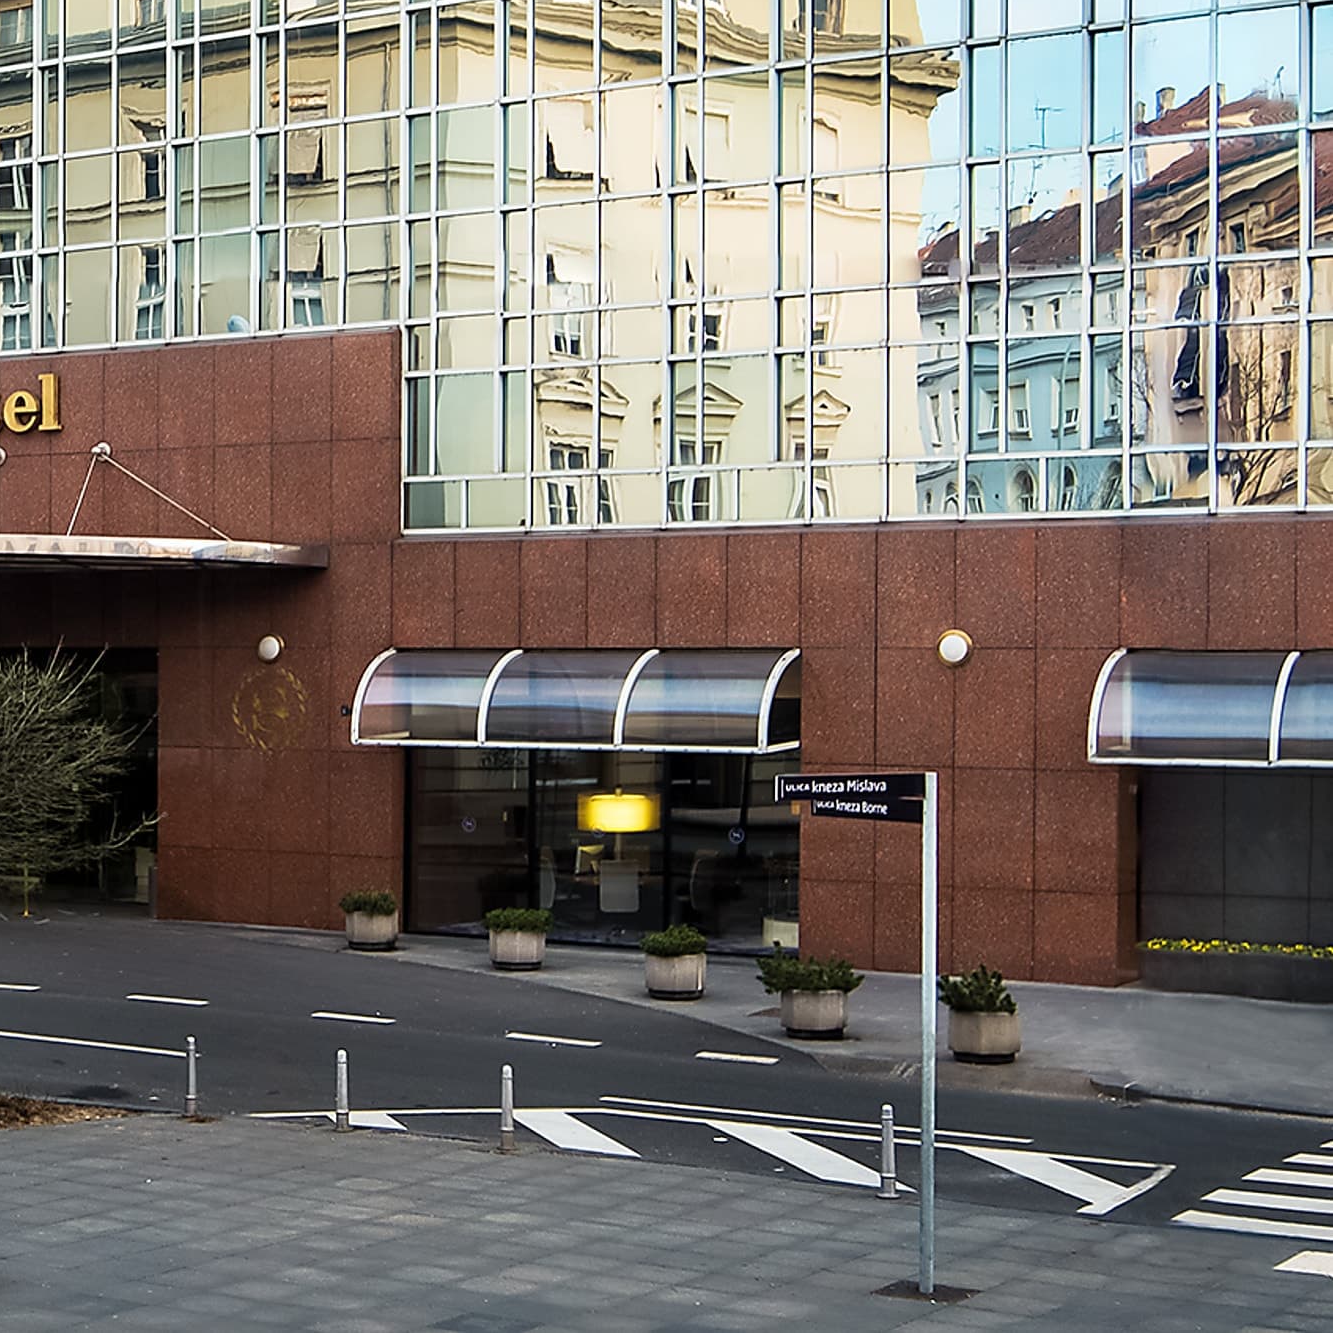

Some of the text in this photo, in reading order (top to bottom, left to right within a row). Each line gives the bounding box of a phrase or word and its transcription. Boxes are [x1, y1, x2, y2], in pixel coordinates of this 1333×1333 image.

[811, 779, 845, 794] kneza
[846, 778, 887, 793] Mislava
[836, 798, 861, 813] kneza
